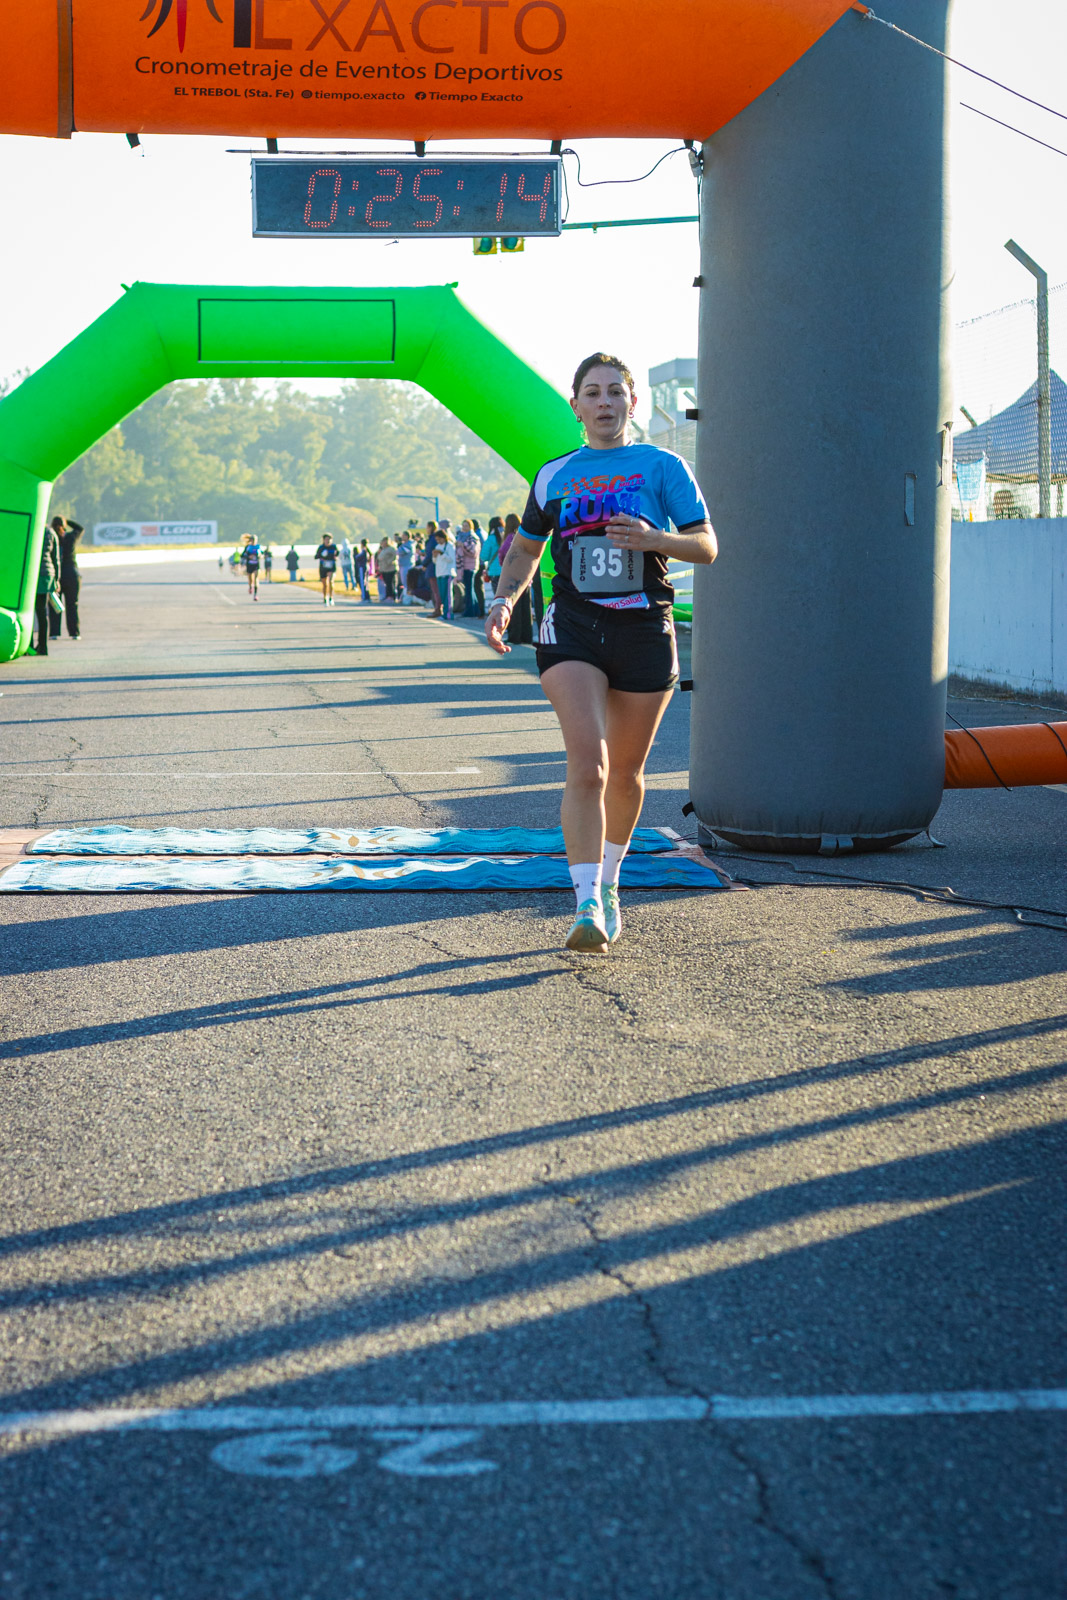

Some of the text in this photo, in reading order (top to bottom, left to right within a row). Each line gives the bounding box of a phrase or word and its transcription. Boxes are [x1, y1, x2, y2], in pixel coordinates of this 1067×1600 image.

[135, 56, 563, 84] Cronometraje de Eventos Deportivos
[174, 87, 294, 100] EL TREBOL (Sta. Fe)
[429, 91, 523, 103] Tiempo Exacto
[579, 547, 587, 581] TIEMPO
[591, 547, 623, 578] 35
[620, 594, 643, 607] Salud
